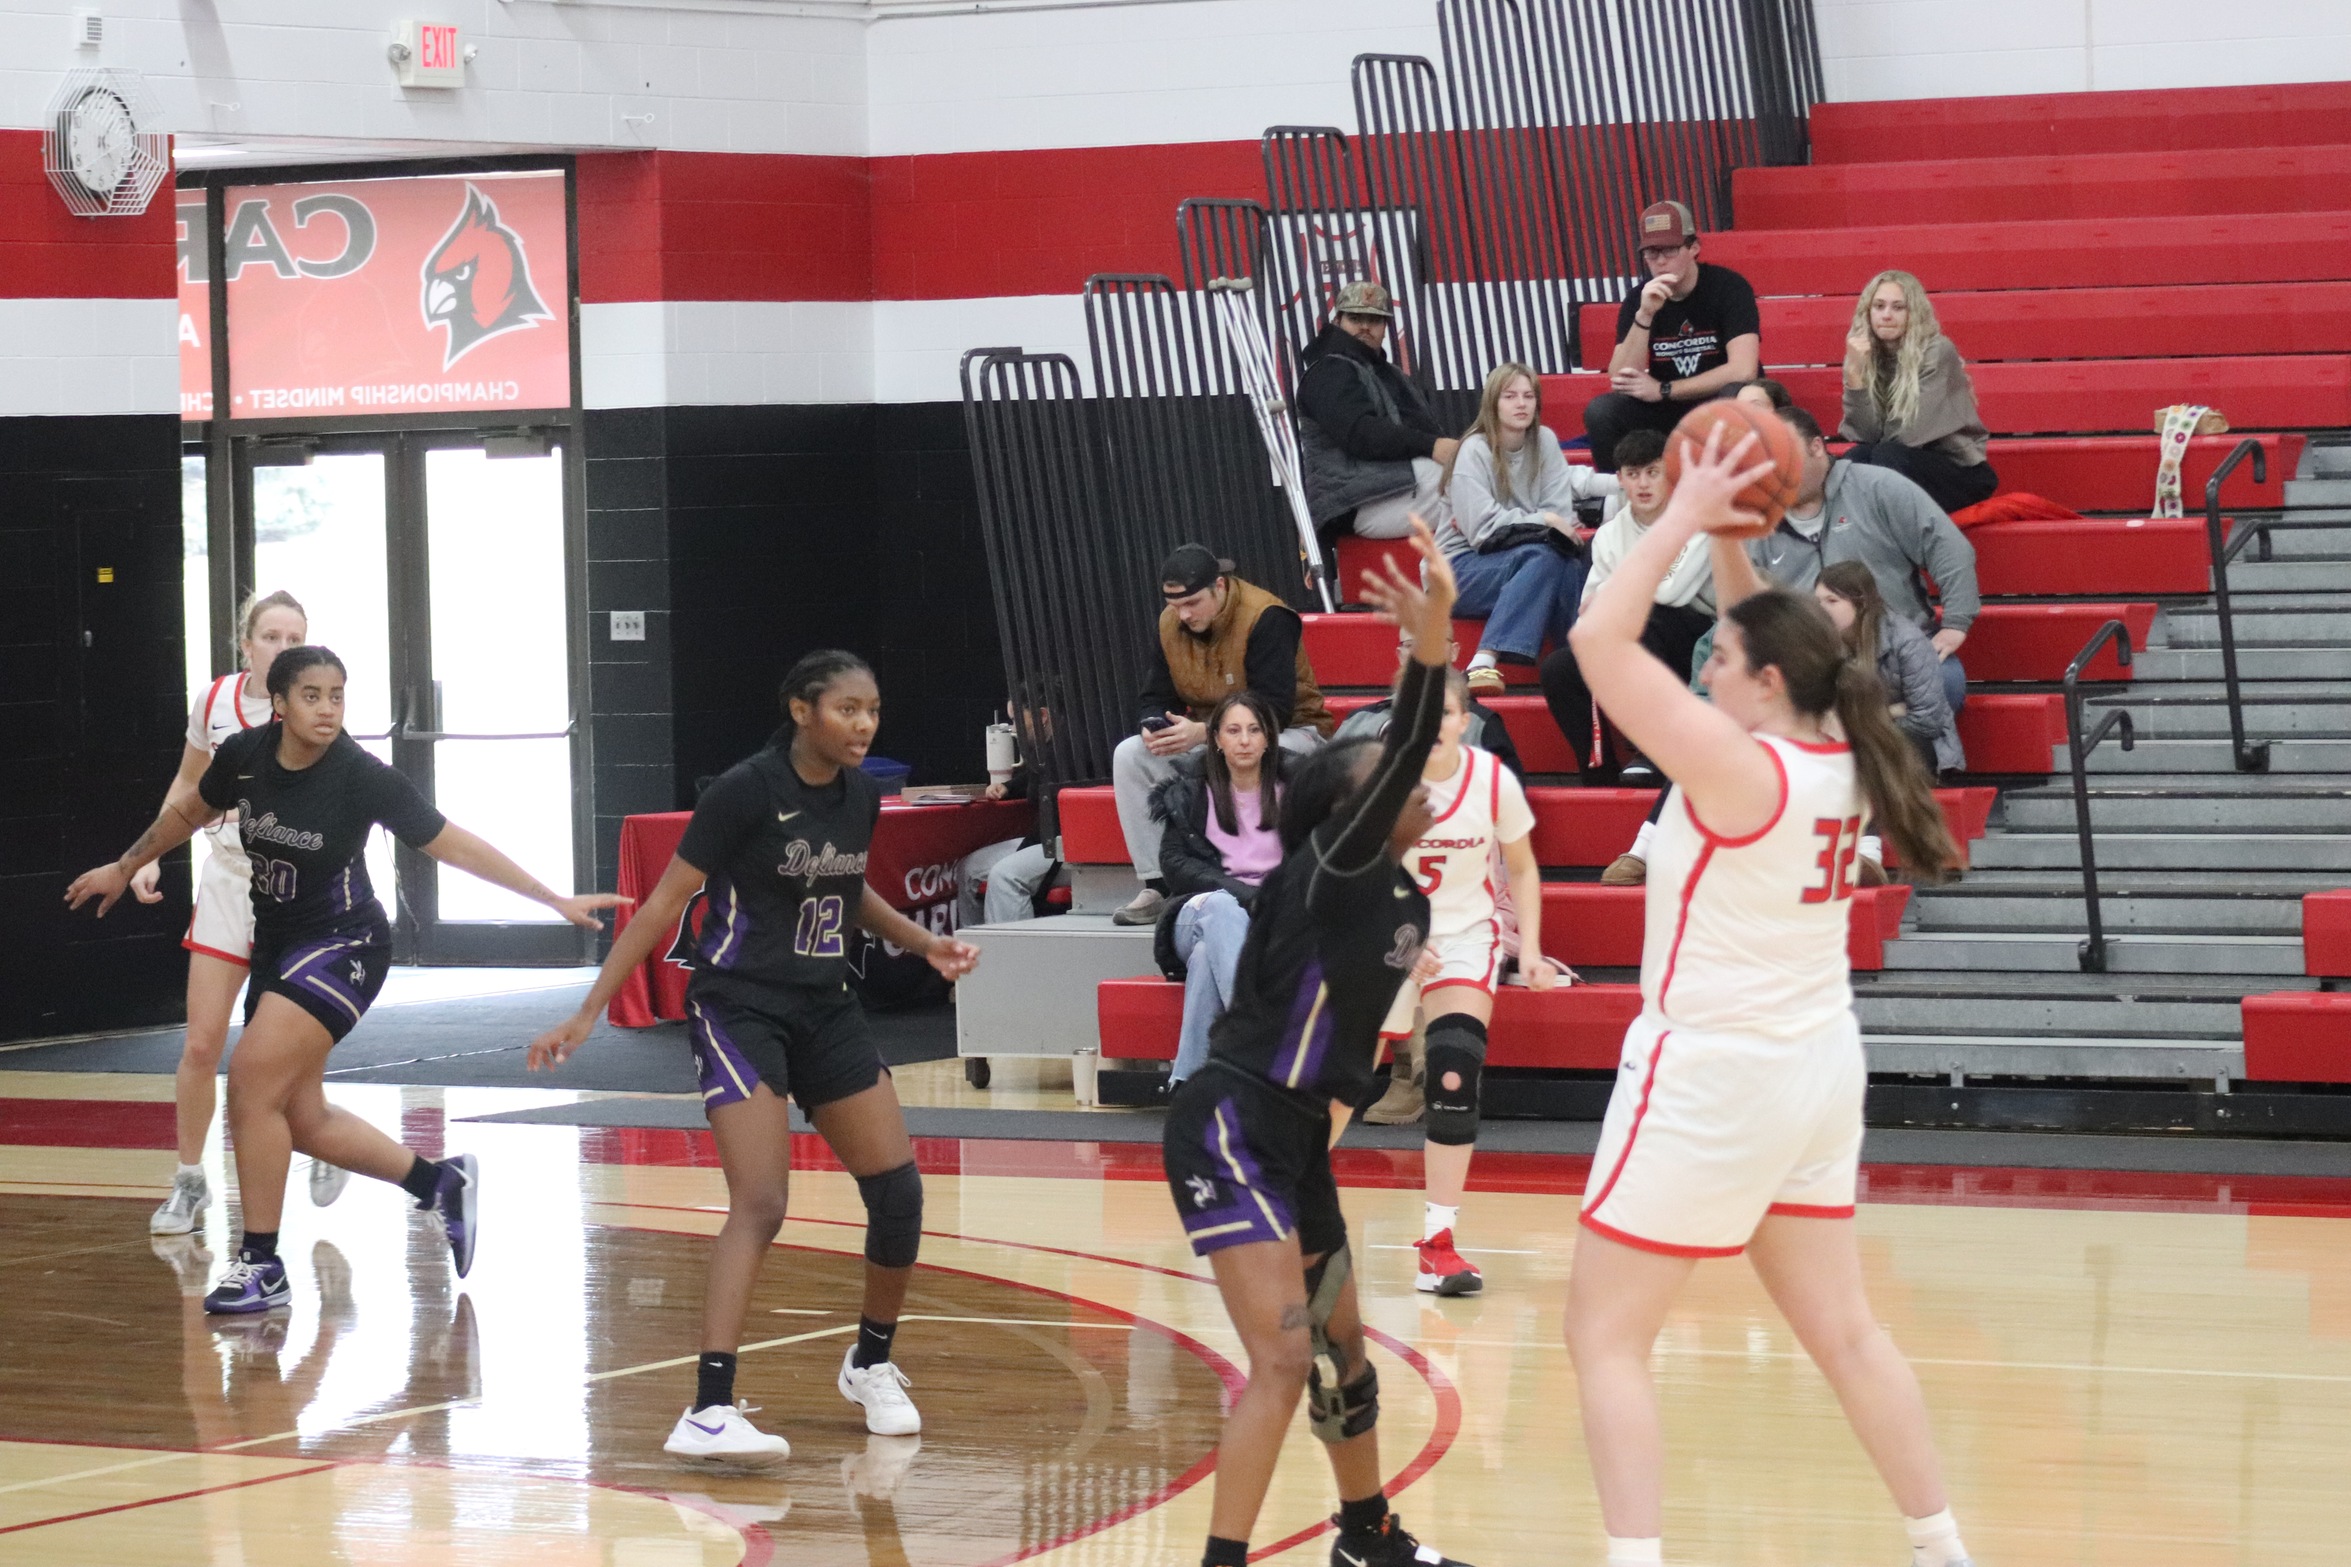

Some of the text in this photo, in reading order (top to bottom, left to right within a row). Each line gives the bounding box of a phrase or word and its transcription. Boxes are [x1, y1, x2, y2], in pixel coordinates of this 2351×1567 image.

[422, 26, 457, 69] EXIT
[1653, 335, 1718, 351] CONCORDIA
[1417, 855, 1447, 897] 5
[1799, 815, 1861, 904] 32
[795, 895, 844, 957] 12
